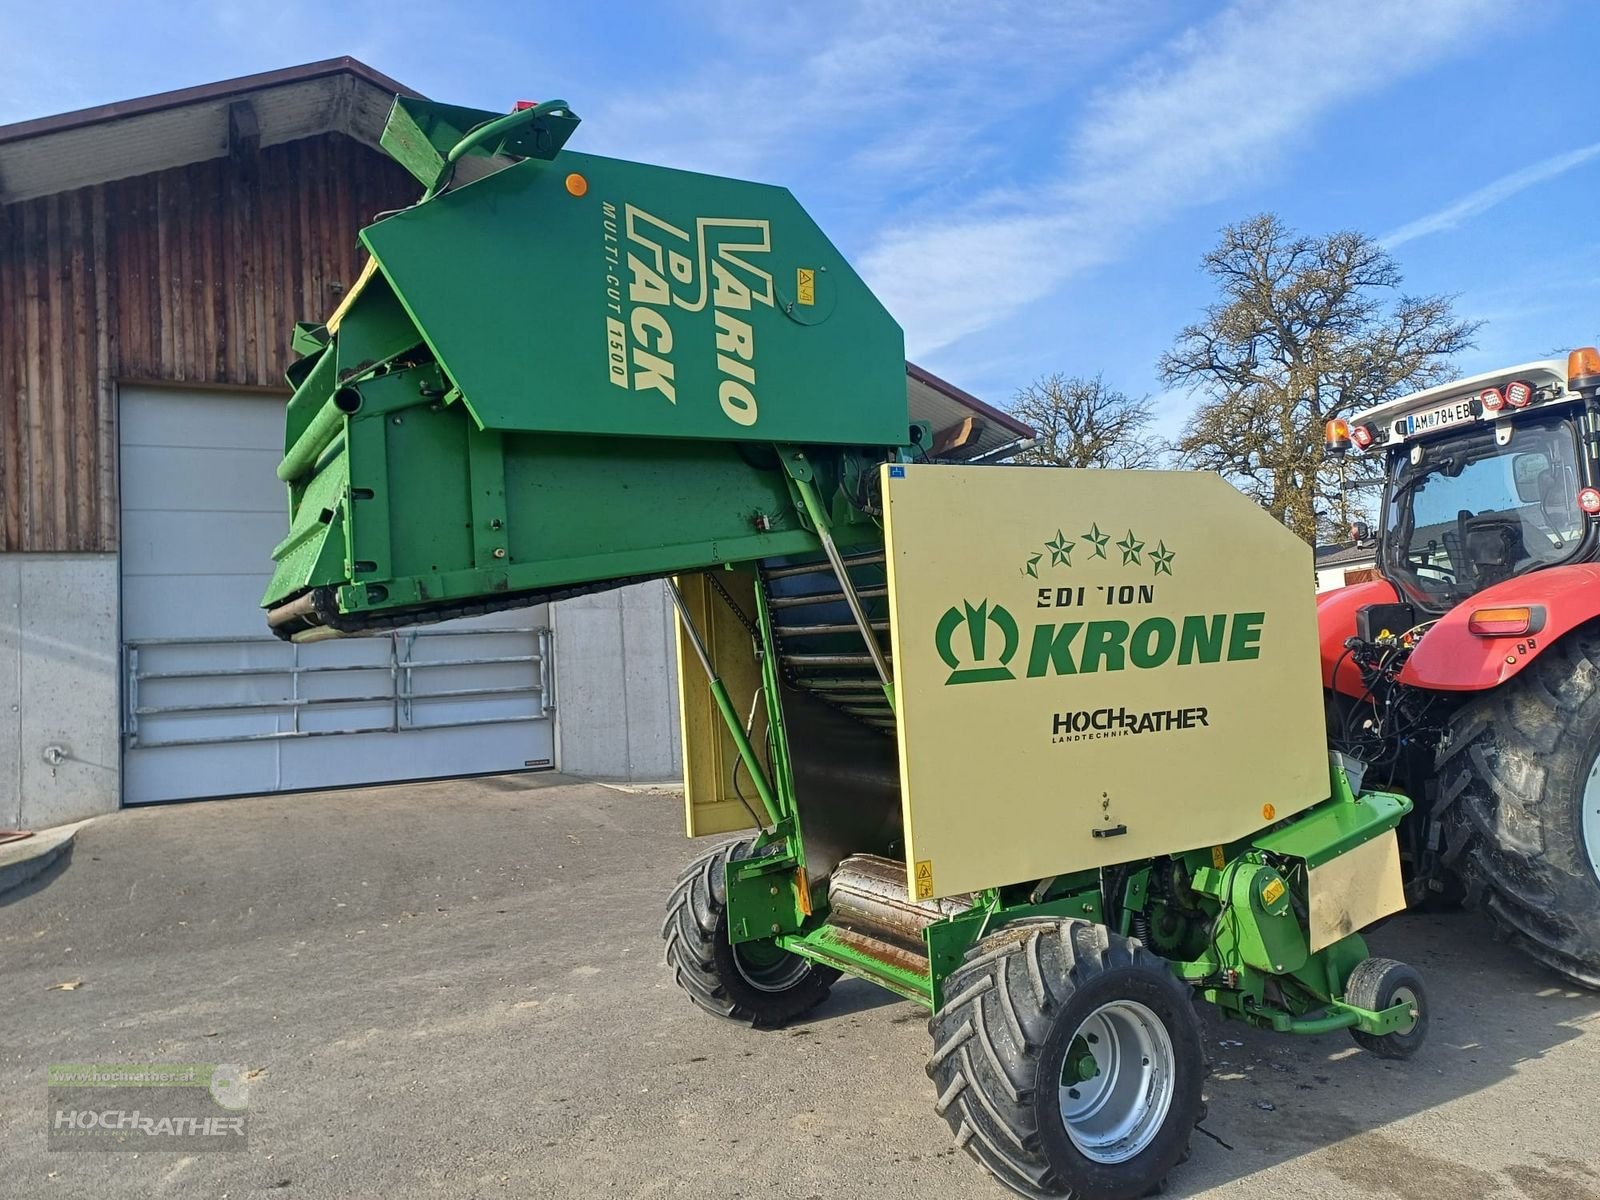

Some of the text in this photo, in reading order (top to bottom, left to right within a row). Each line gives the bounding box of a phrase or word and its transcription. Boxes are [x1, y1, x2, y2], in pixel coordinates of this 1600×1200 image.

[602, 201, 625, 377] MULTI-CUT 1500
[1415, 403, 1470, 431] AM 784 EB
[1037, 585, 1154, 608] EDIION
[1026, 612, 1266, 678] KRONE
[1052, 707, 1209, 735] HOCHRATHER
[1052, 730, 1129, 744] LANDTECHNIK
